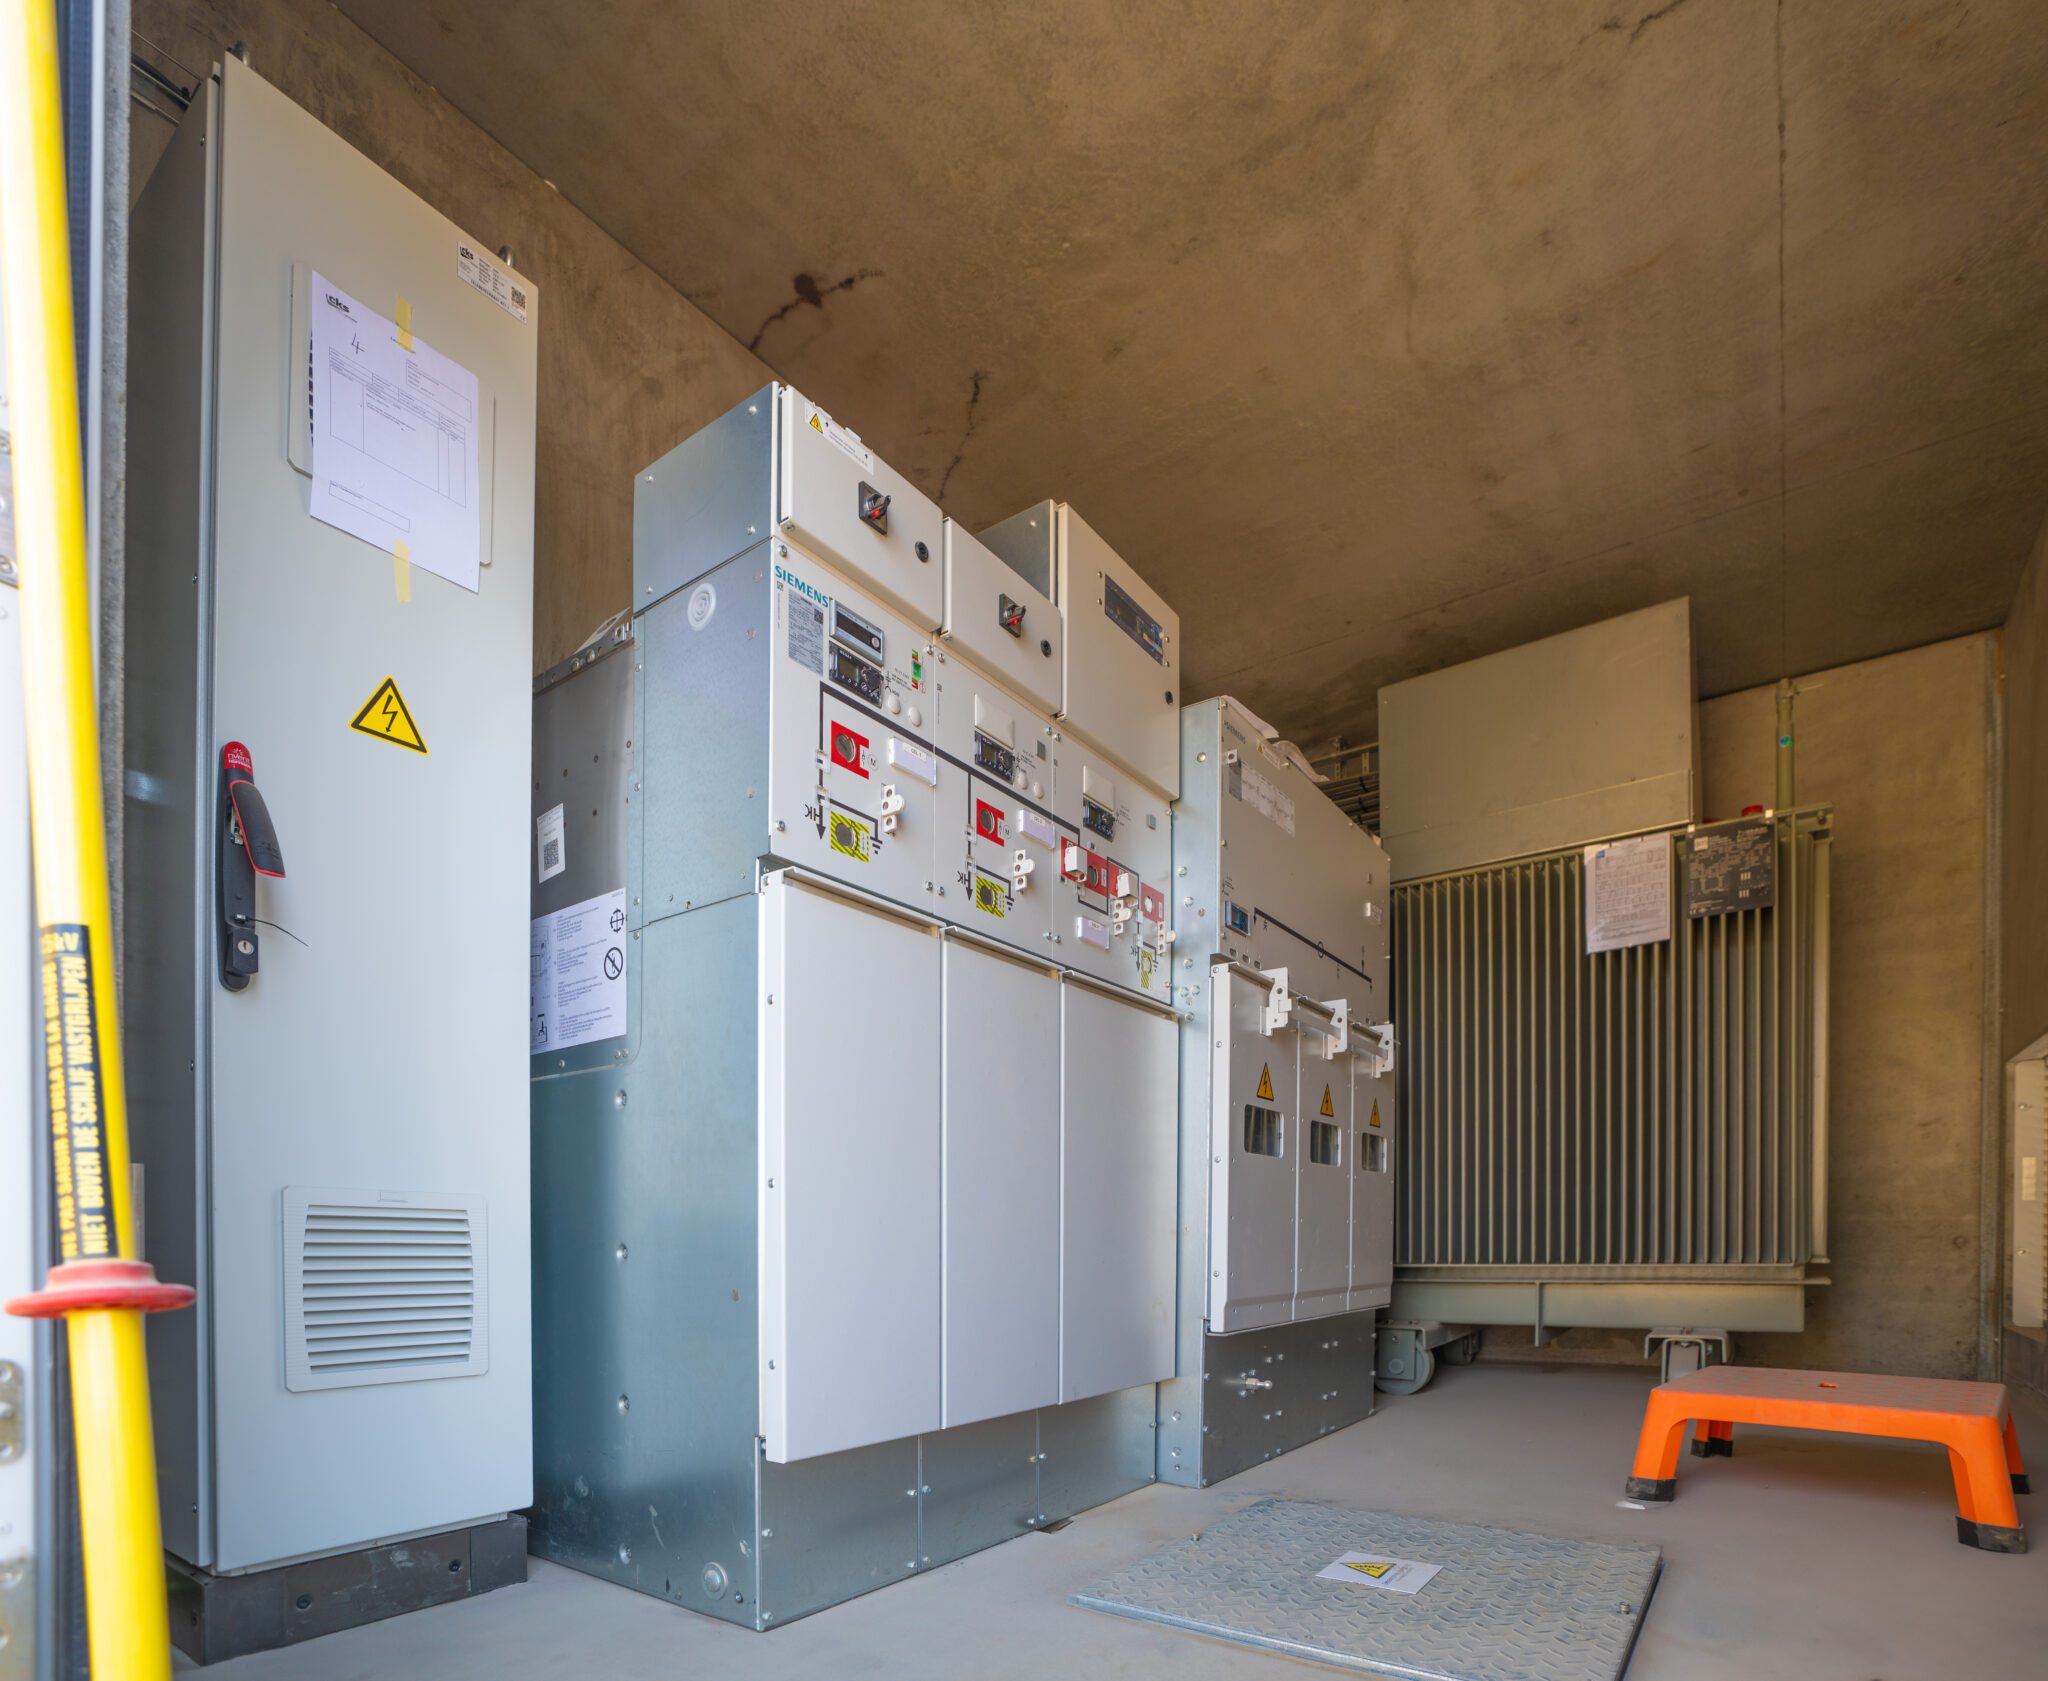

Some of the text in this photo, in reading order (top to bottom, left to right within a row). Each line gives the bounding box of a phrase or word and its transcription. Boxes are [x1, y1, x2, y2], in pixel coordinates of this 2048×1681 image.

[326, 294, 350, 313] cks
[351, 332, 365, 354] 4
[775, 565, 829, 608] SIEMENS
[61, 956, 109, 1254] NIET BOVEN DE SCHIJF VASTGRIJPEN
